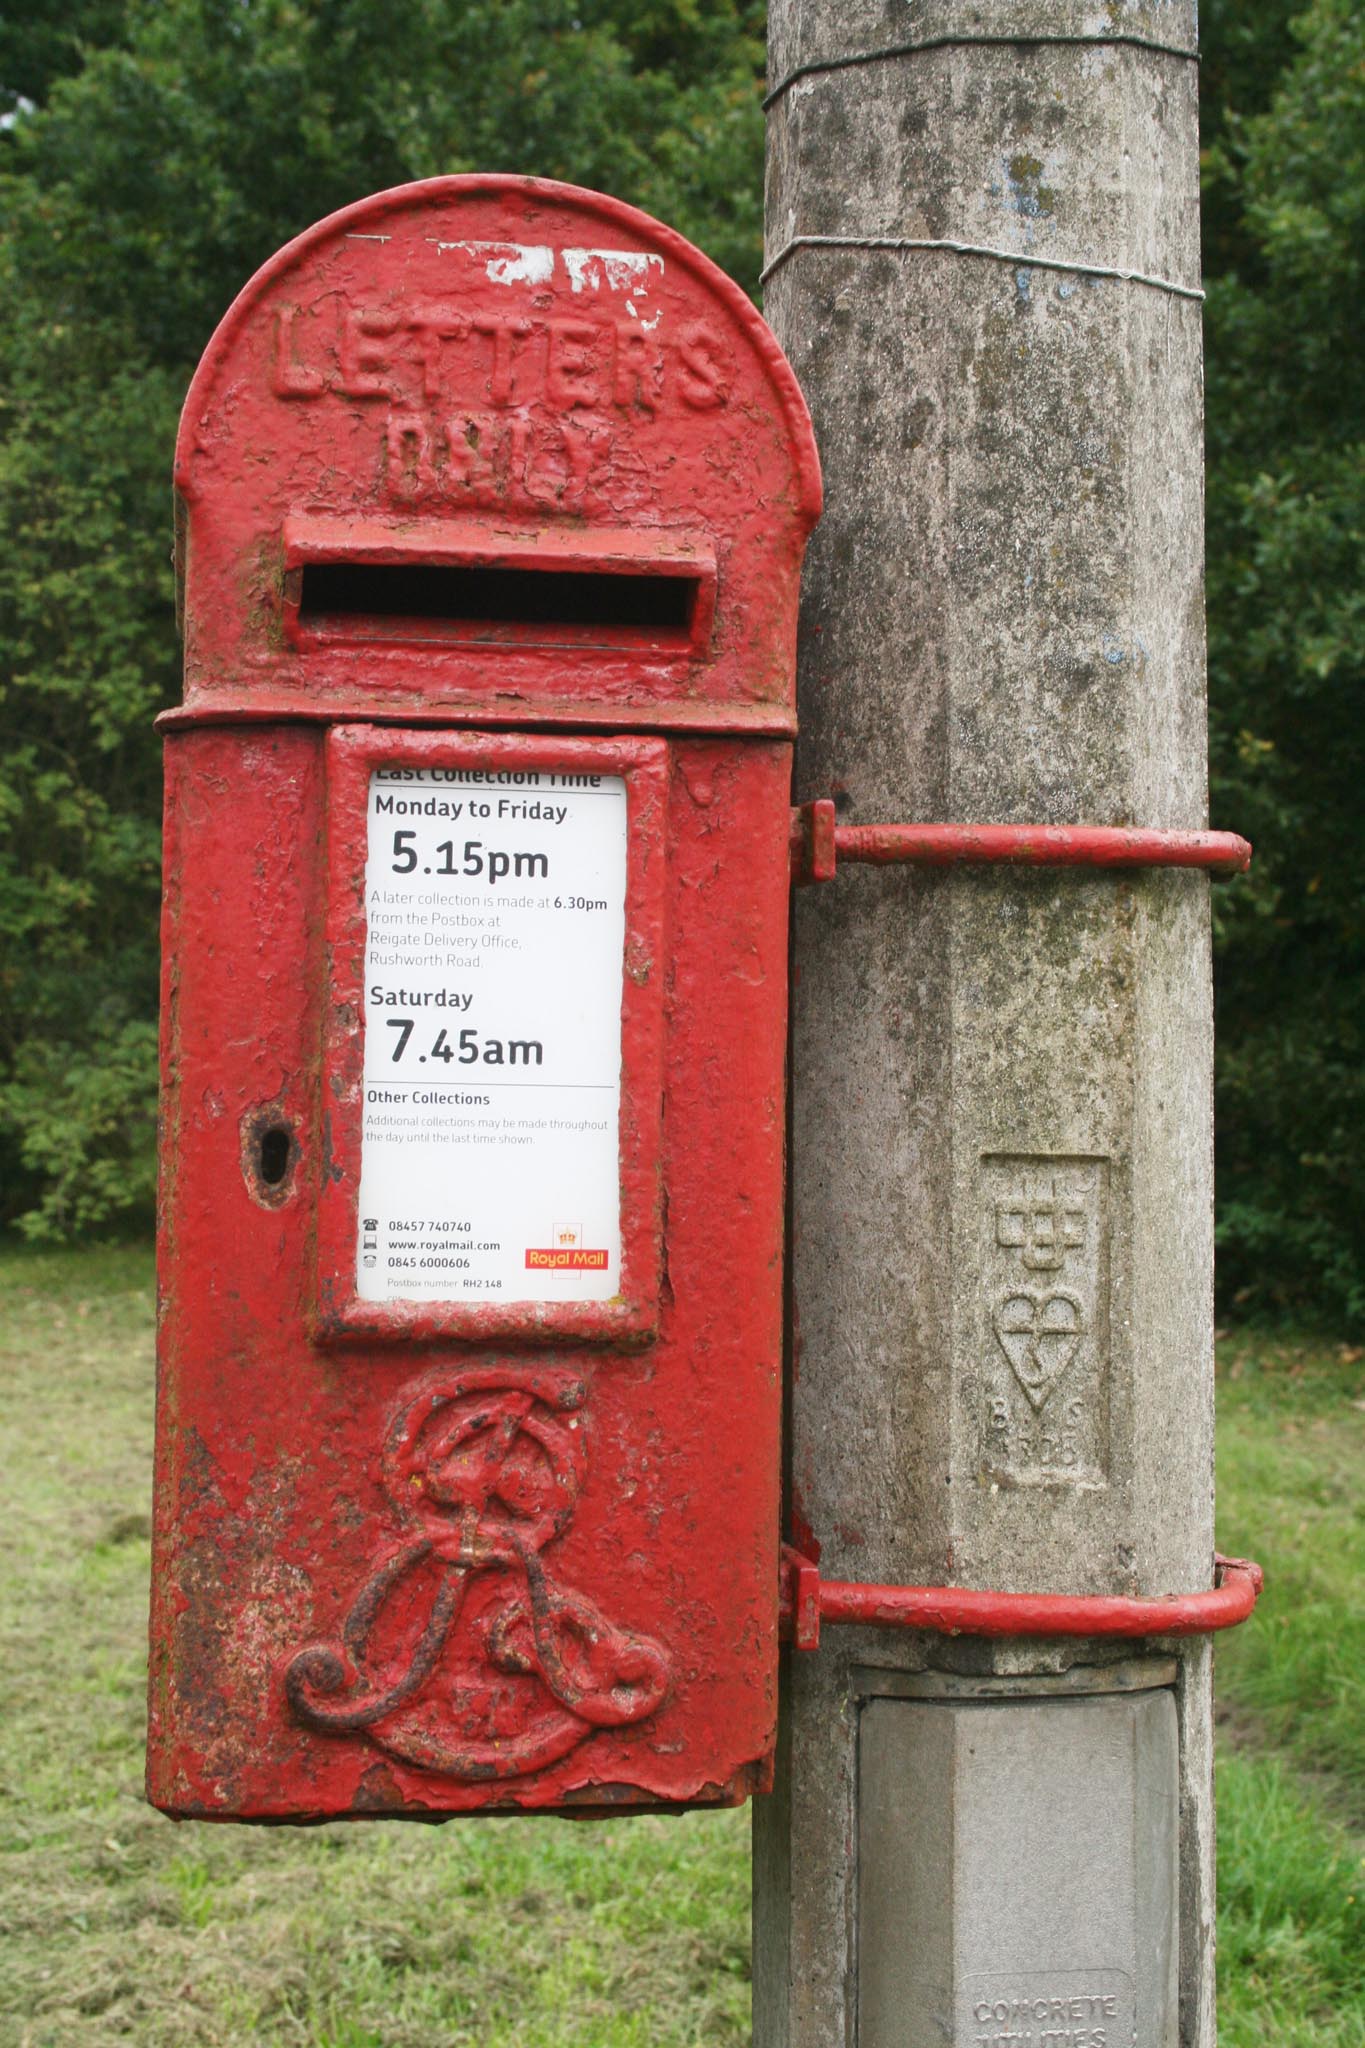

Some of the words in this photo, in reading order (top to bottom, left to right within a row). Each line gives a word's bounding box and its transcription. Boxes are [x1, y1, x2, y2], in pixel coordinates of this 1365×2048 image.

[273, 306, 732, 417] LETTERS
[375, 795, 463, 821] Monday
[469, 800, 490, 817] to
[498, 800, 568, 824] Friday
[391, 830, 549, 885] 5.15pm
[370, 890, 380, 903] A
[383, 891, 413, 904] later
[418, 891, 480, 906] collection
[484, 896, 494, 907] is
[497, 896, 534, 909] made
[537, 898, 550, 909] at
[554, 896, 608, 912] 6.30pm
[370, 911, 403, 924] from
[407, 912, 428, 925] the
[431, 912, 485, 927] Postbox
[488, 916, 501, 928] at
[370, 931, 421, 948] Reigate
[424, 932, 478, 950] Delivery
[370, 951, 443, 966] Rushworth
[370, 986, 473, 1011] Saturday
[386, 1018, 543, 1066] 7.45am
[367, 1090, 409, 1104] Other
[412, 1091, 490, 1106] Collections
[366, 1115, 419, 1127] Additional
[421, 1116, 476, 1128] collections
[478, 1119, 501, 1130] may
[503, 1117, 516, 1129] be
[518, 1119, 547, 1130] made
[549, 1119, 608, 1132] throughout
[366, 1132, 384, 1142] the
[385, 1132, 404, 1145] day
[407, 1132, 430, 1144] until
[432, 1133, 450, 1144] the
[451, 1133, 471, 1144] last
[473, 1134, 497, 1145] time
[498, 1133, 536, 1146] shown.
[388, 1220, 425, 1232] 08457
[428, 1221, 471, 1233] 740740
[388, 1239, 501, 1252] www.royalmail.com
[387, 1257, 417, 1268] 0845
[419, 1258, 470, 1269] 6000606
[530, 1251, 570, 1268] Royal
[573, 1253, 604, 1266] Mail
[387, 1278, 421, 1289] Postbox
[423, 1279, 458, 1289] number
[463, 1279, 483, 1289] RH2
[485, 1280, 502, 1289] 148
[974, 1995, 1117, 2023] CONCRETE
